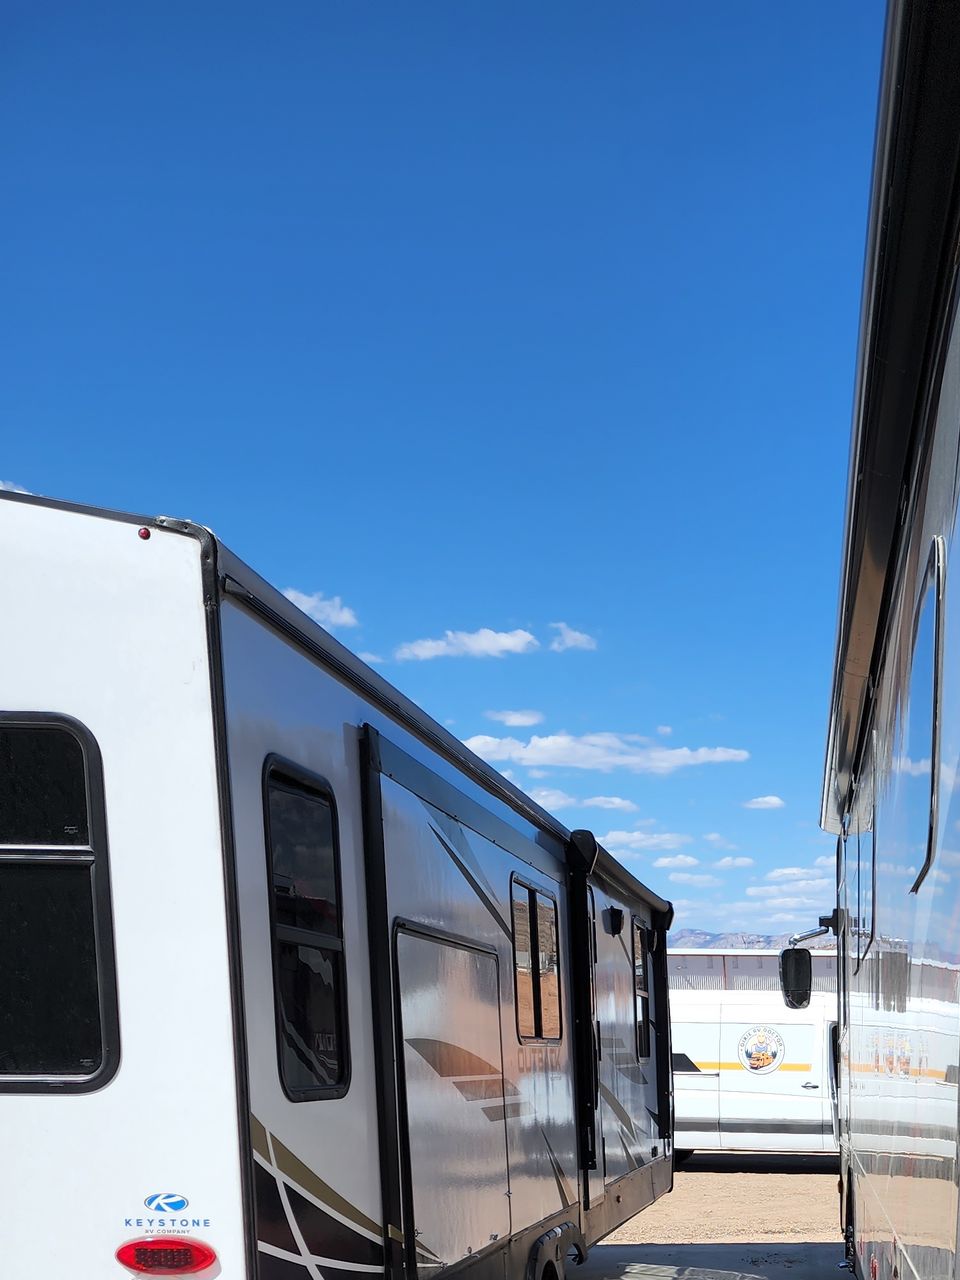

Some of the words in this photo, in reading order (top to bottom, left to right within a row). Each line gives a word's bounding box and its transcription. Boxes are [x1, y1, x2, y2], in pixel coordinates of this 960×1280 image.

[763, 1028, 783, 1047] DOCTOR
[518, 1047, 561, 1073] OUTBACK
[125, 1218, 211, 1227] KEYSTONE
